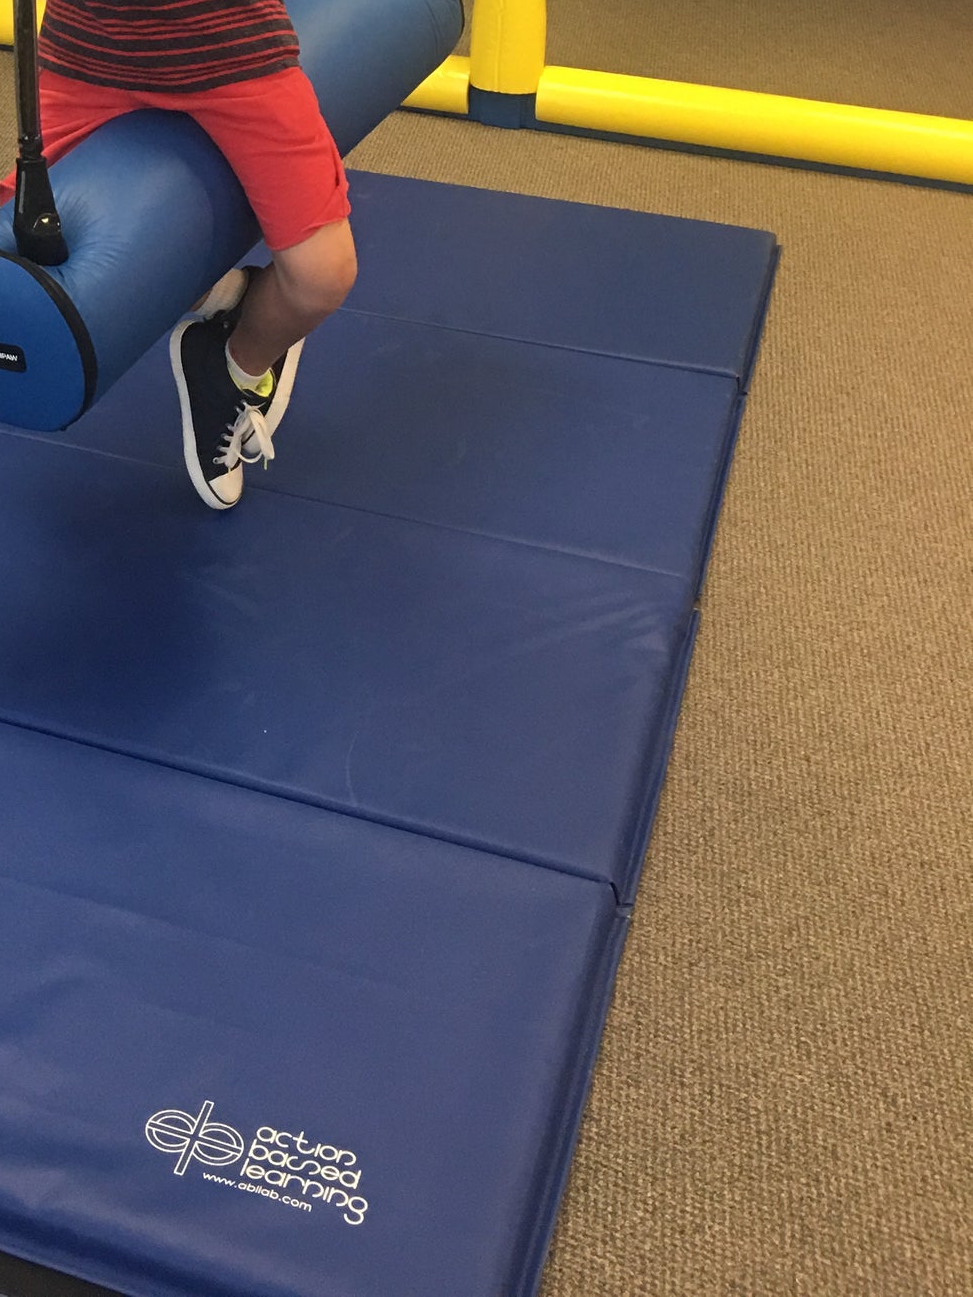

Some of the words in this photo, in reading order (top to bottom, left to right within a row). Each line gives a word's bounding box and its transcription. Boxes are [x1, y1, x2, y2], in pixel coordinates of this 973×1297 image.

[248, 1138, 362, 1189] based
[256, 1126, 357, 1166] action
[240, 1158, 369, 1225] learning
